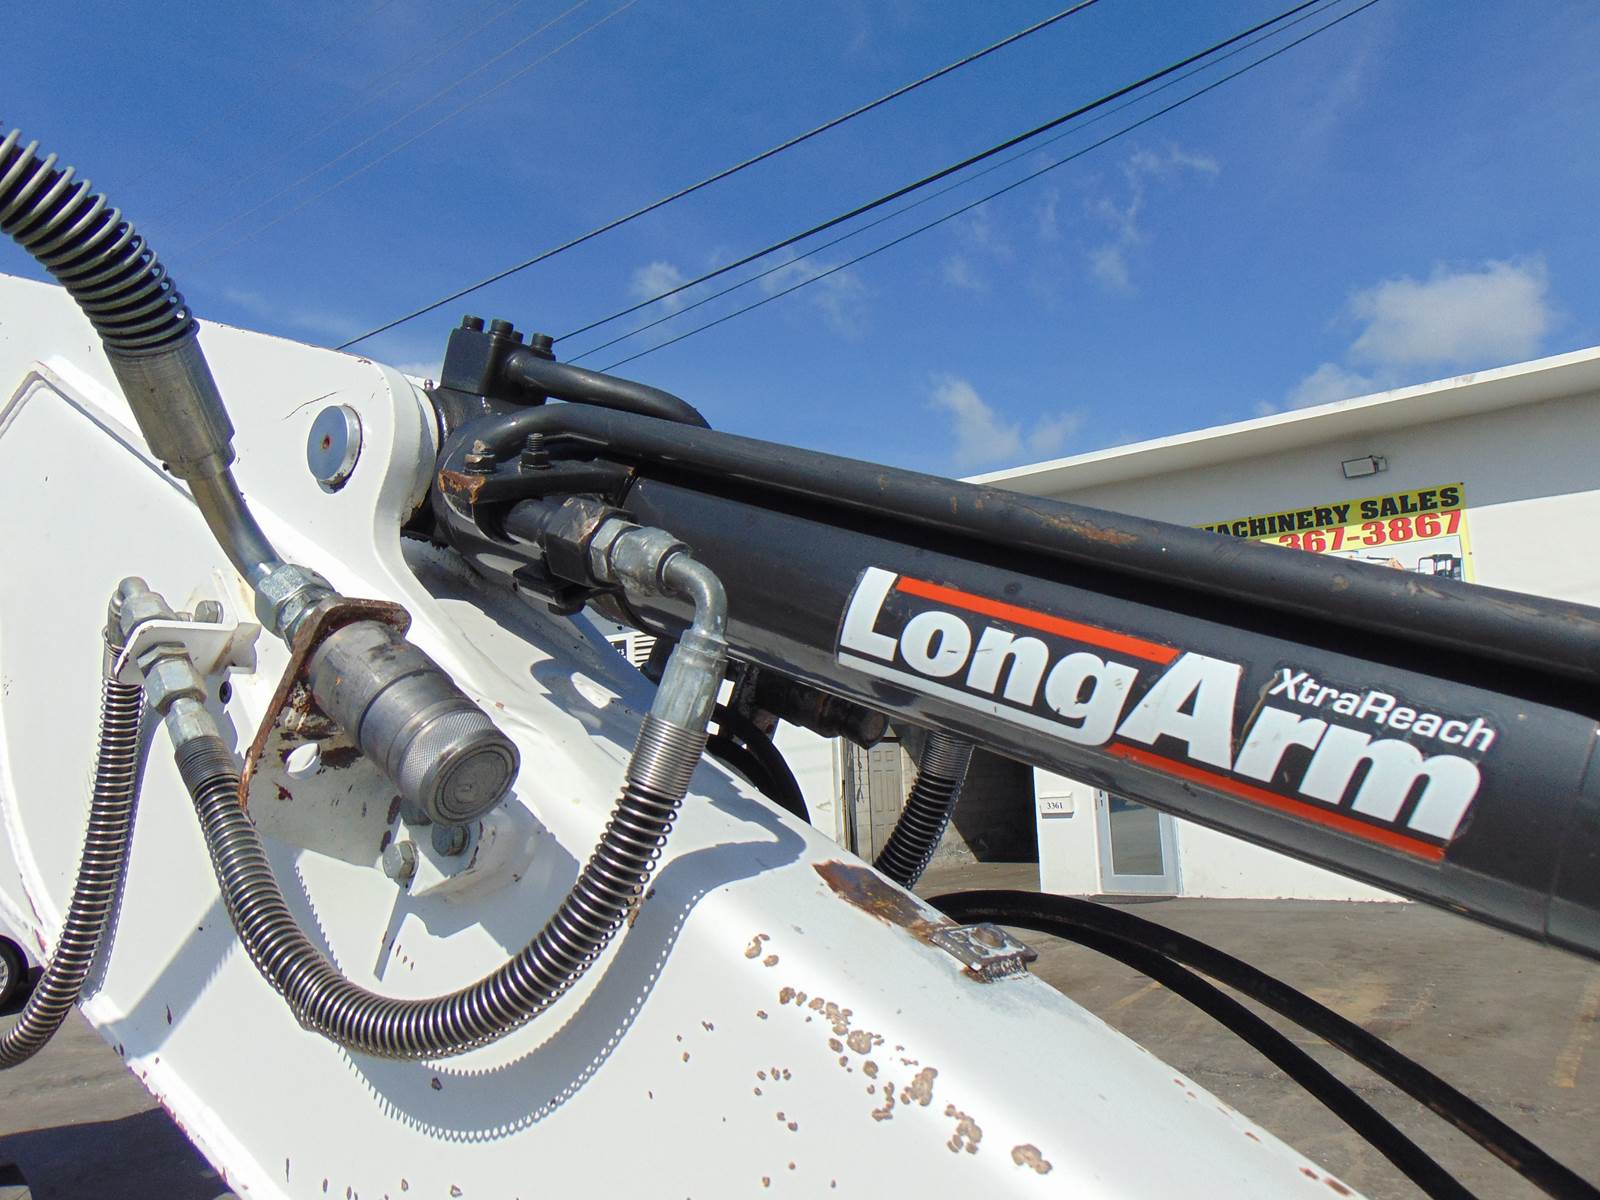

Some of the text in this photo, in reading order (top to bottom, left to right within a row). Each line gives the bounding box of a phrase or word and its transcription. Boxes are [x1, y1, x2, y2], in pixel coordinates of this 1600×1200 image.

[1202, 487, 1459, 538] ACHINERY SALES
[1273, 668, 1496, 752] XtraReach
[1046, 801, 1064, 810] 3361
